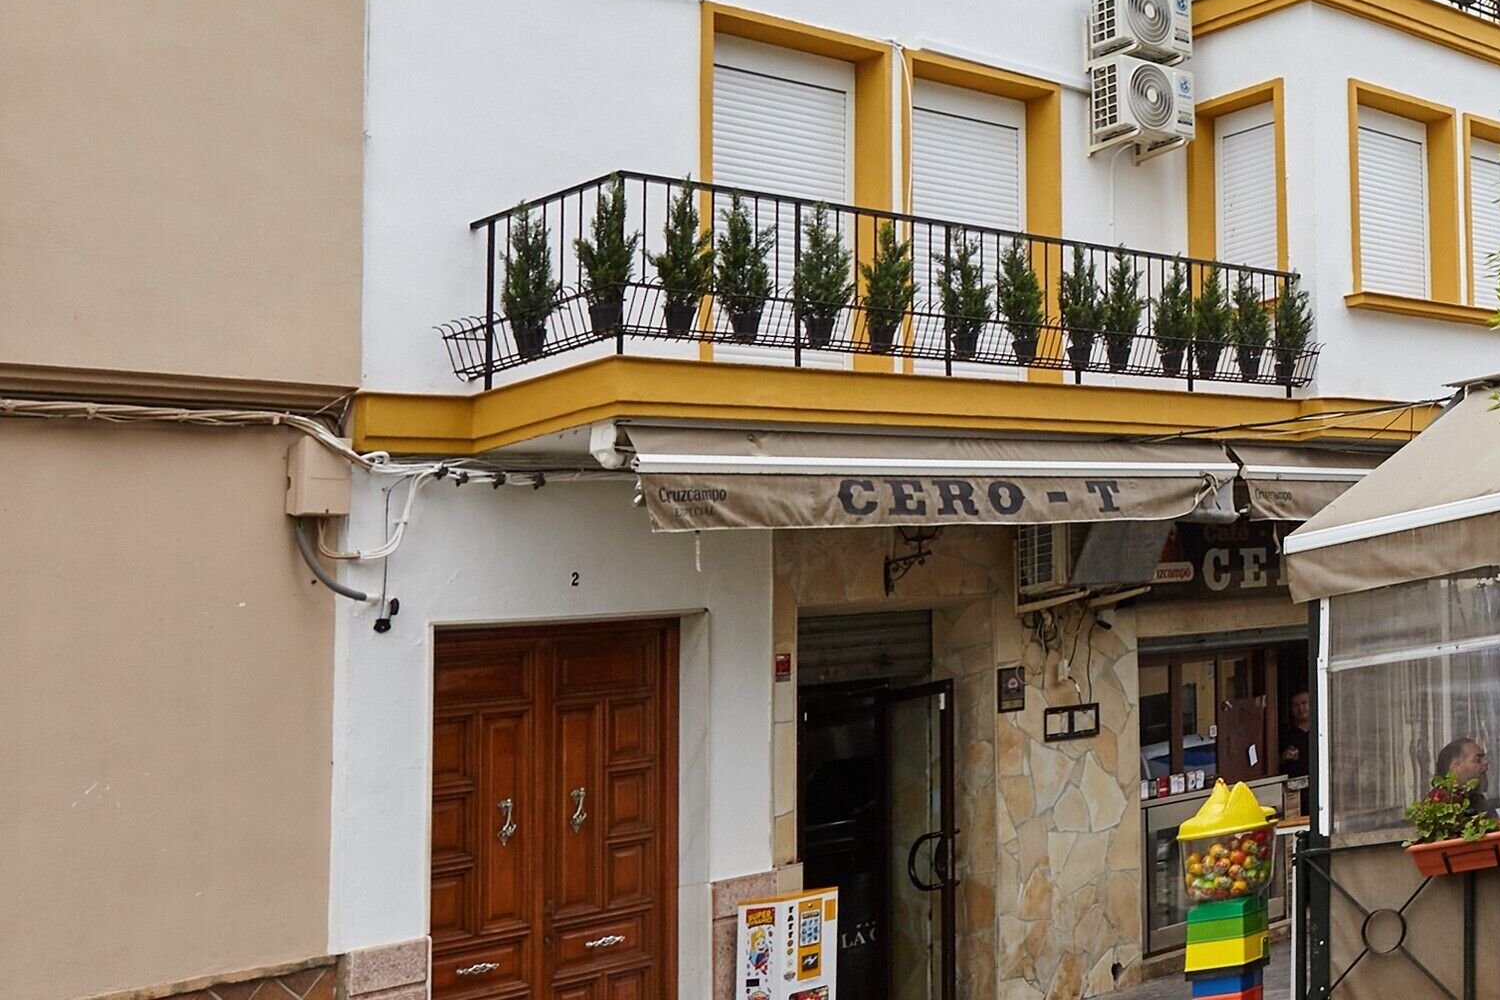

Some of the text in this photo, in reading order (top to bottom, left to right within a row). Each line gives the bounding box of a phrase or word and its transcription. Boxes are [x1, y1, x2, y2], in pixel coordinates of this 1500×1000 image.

[658, 487, 727, 502] Cruzcampo
[837, 479, 1026, 516] CERO
[1085, 480, 1120, 513] T
[571, 571, 580, 586] 2
